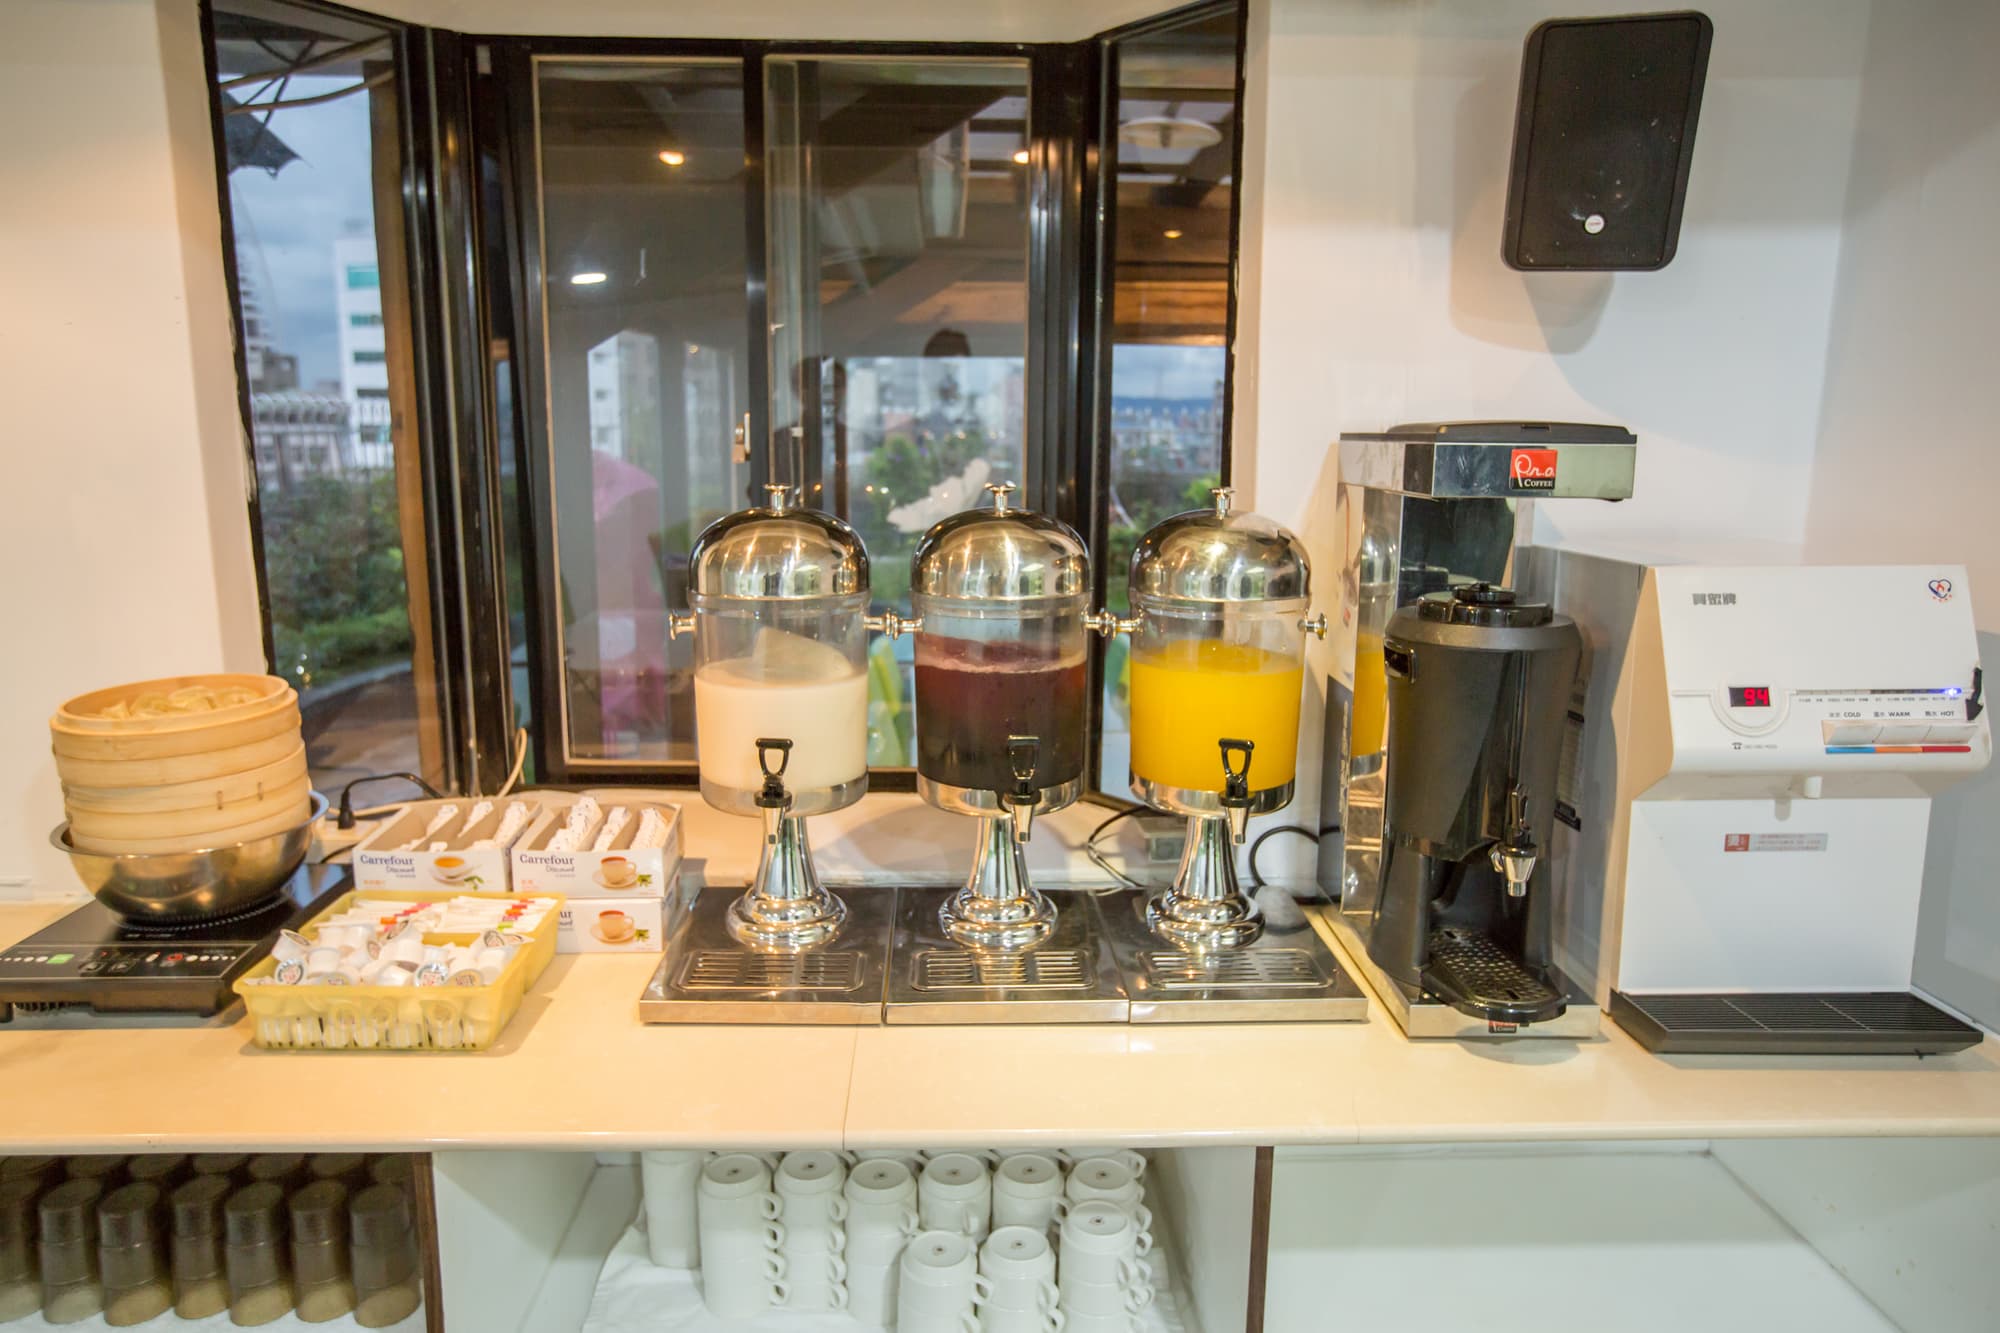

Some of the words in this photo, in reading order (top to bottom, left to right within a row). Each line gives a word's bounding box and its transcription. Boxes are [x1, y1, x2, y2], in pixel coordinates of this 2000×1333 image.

[1744, 687, 1769, 707] 94
[360, 854, 414, 865] Carrefour
[520, 854, 574, 865] Carrefour
